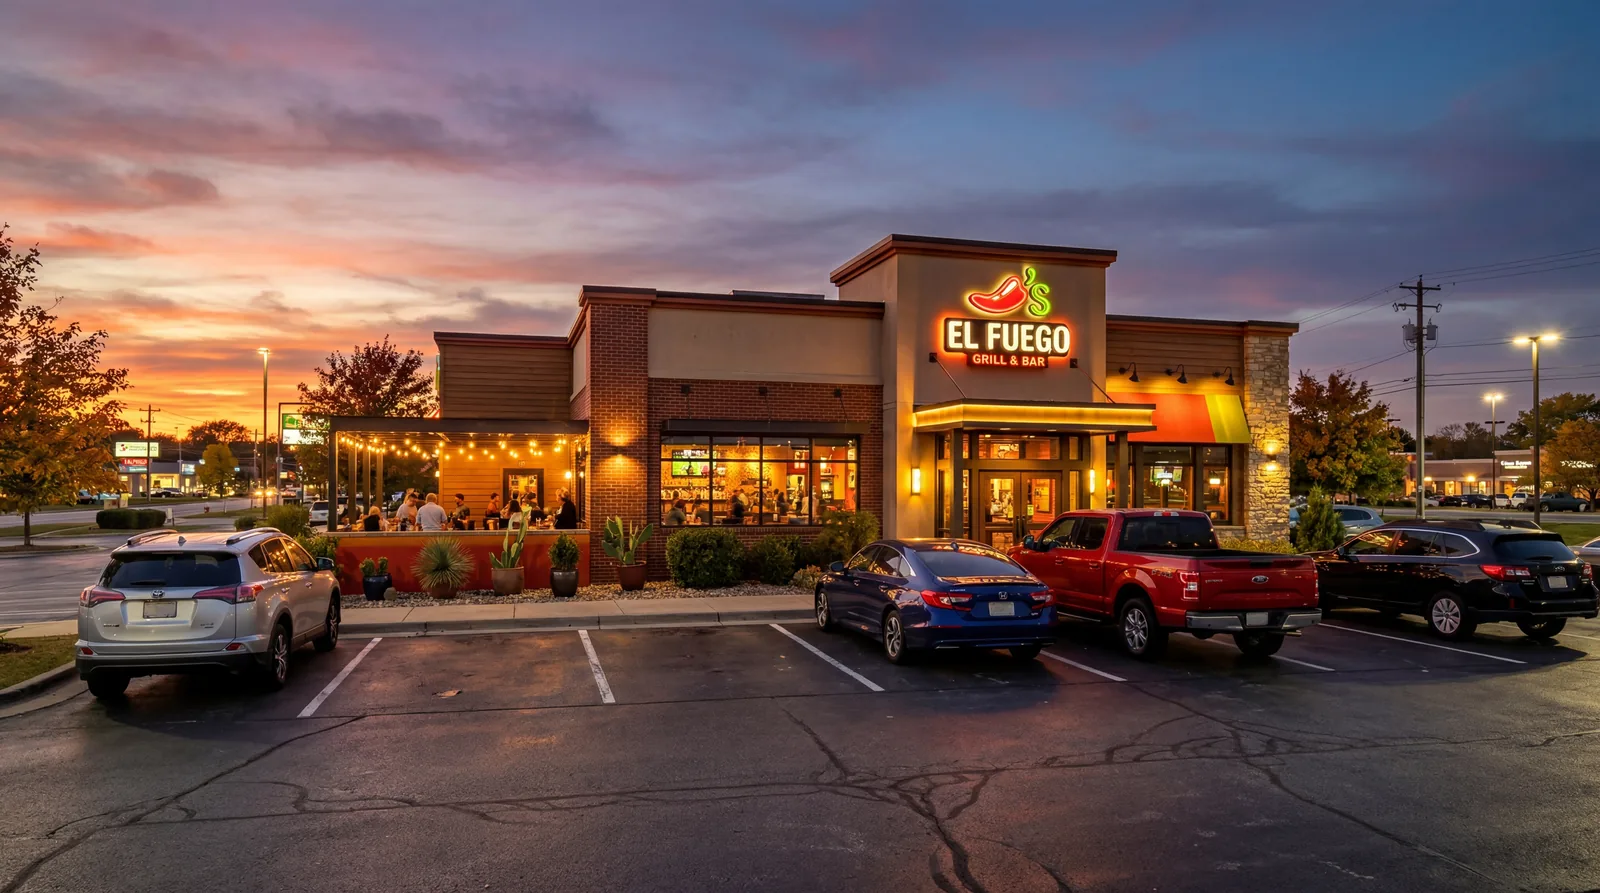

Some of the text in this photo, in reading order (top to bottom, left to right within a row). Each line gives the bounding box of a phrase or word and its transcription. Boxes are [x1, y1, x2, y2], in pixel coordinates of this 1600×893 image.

[948, 321, 1070, 354] EL FUEGO
[972, 354, 1045, 367] GRILL & BAR
